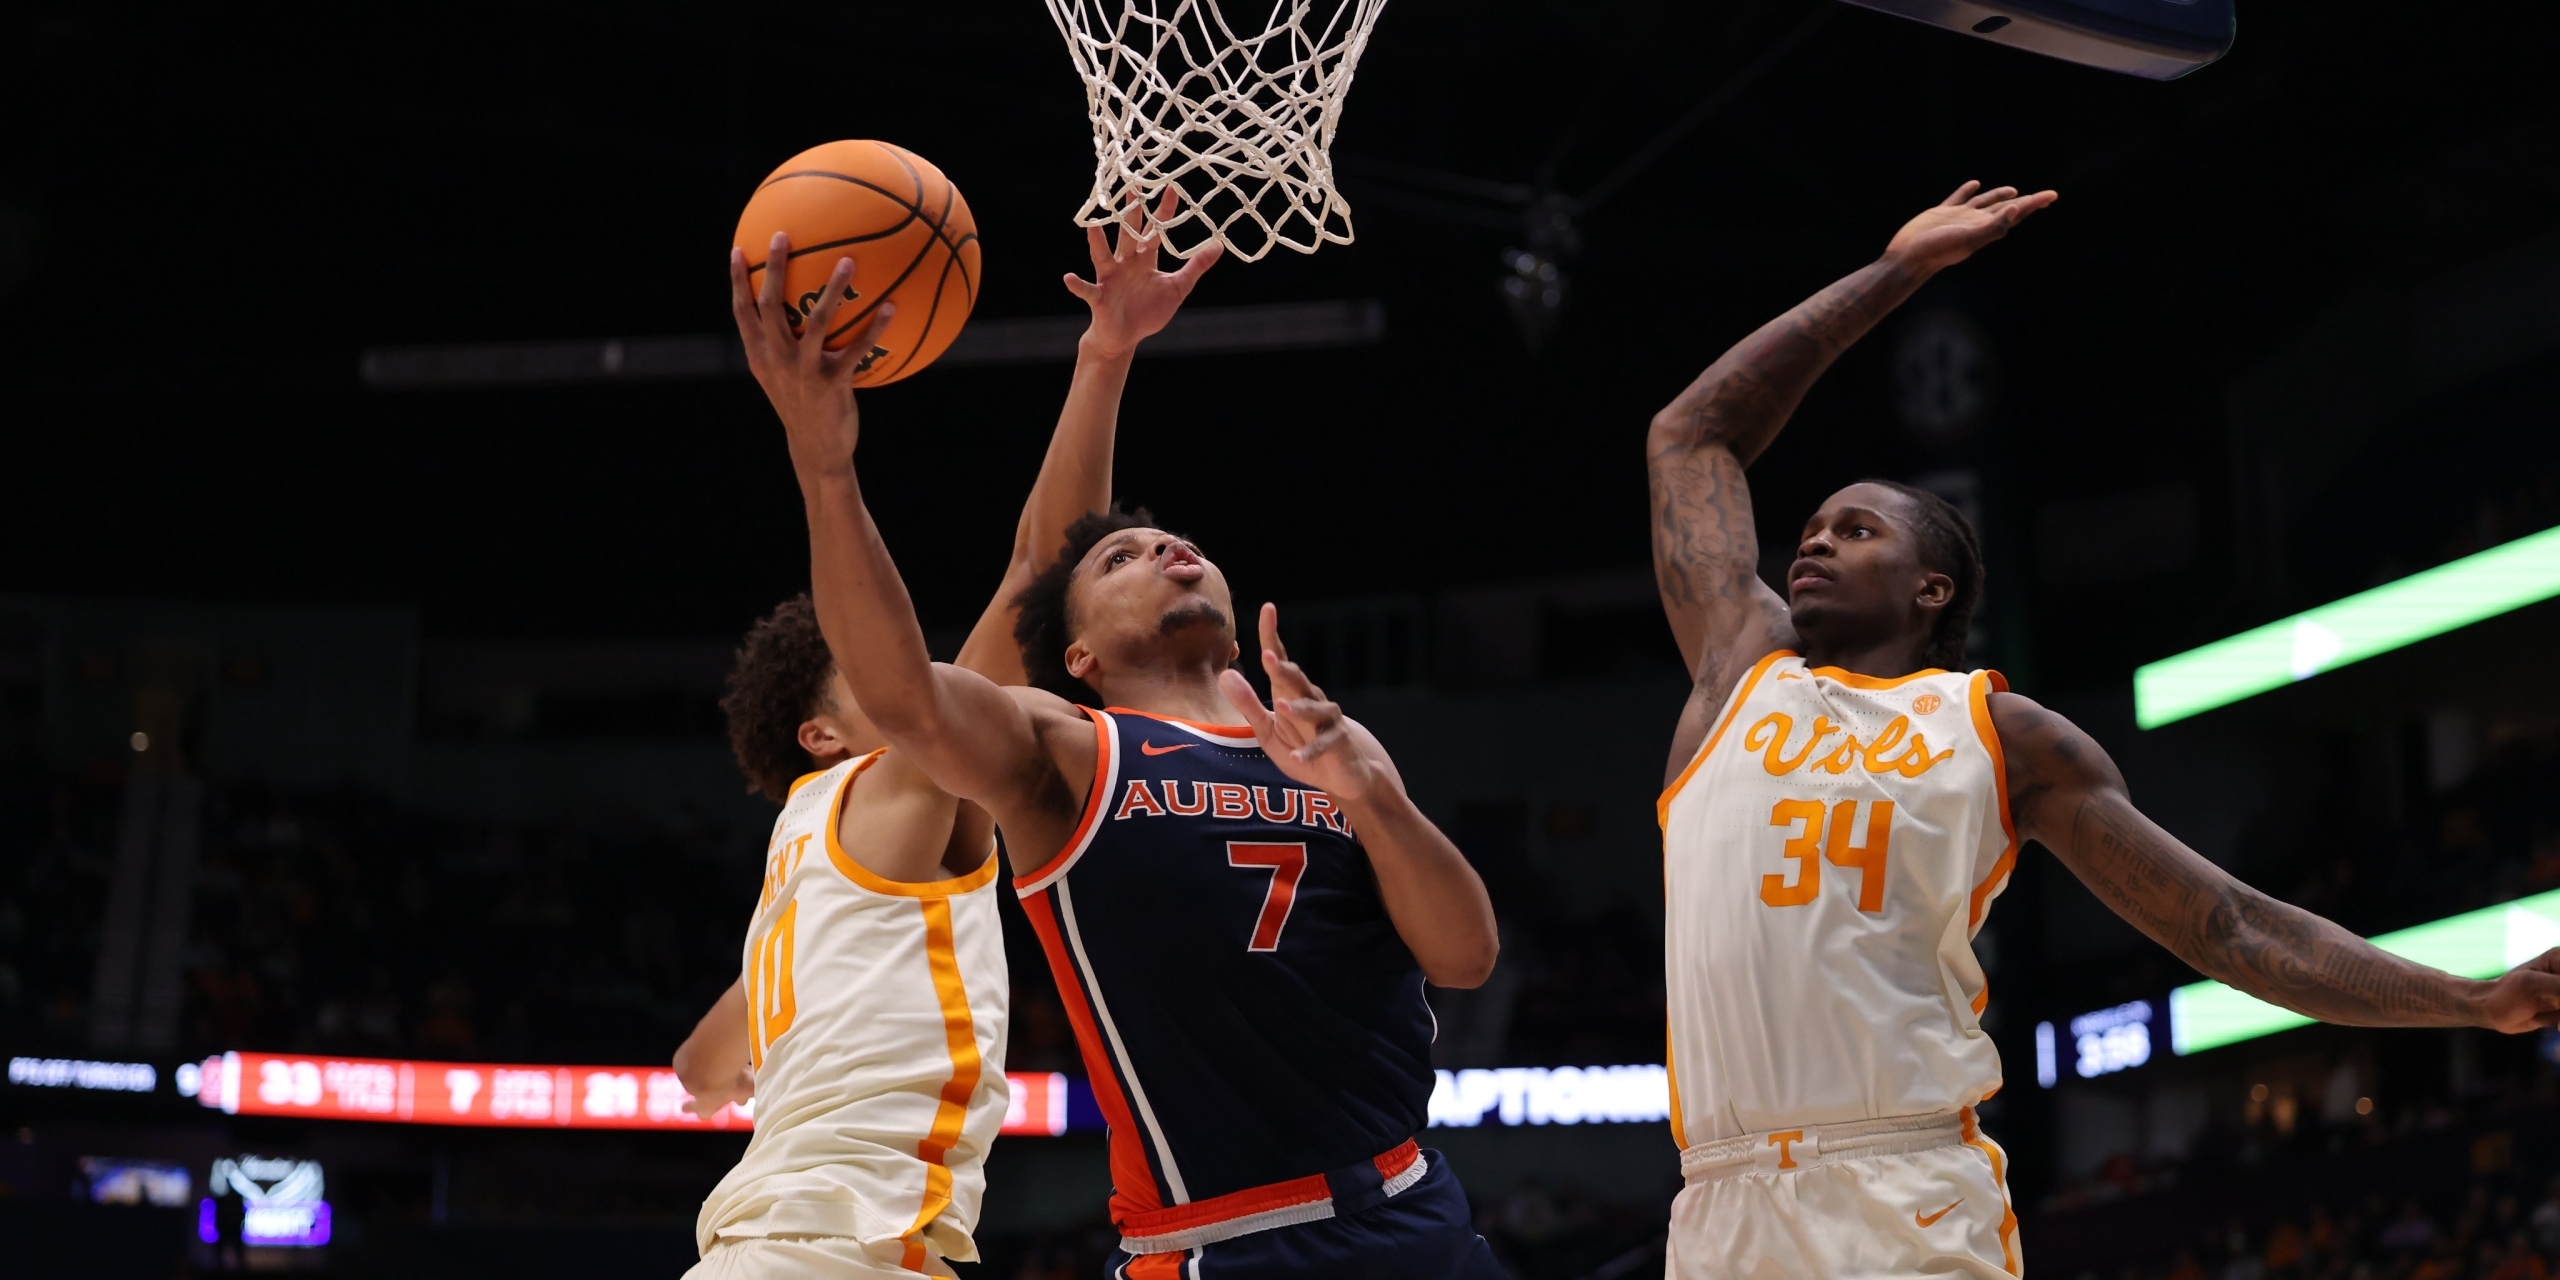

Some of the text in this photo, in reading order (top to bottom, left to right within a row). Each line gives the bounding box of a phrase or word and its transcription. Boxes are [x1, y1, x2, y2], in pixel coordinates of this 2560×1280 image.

[1916, 697, 1939, 714] SEC
[1744, 711, 1955, 778] Vols
[1760, 798, 1895, 913] 34
[2102, 832, 2169, 890] ATTITUDE
[2126, 873, 2140, 892] IS
[1226, 840, 1308, 952] 7
[2088, 866, 2171, 937] EVERYTHING
[748, 898, 798, 1075] 10
[445, 1069, 481, 1115] 7
[1768, 1130, 1803, 1169] T
